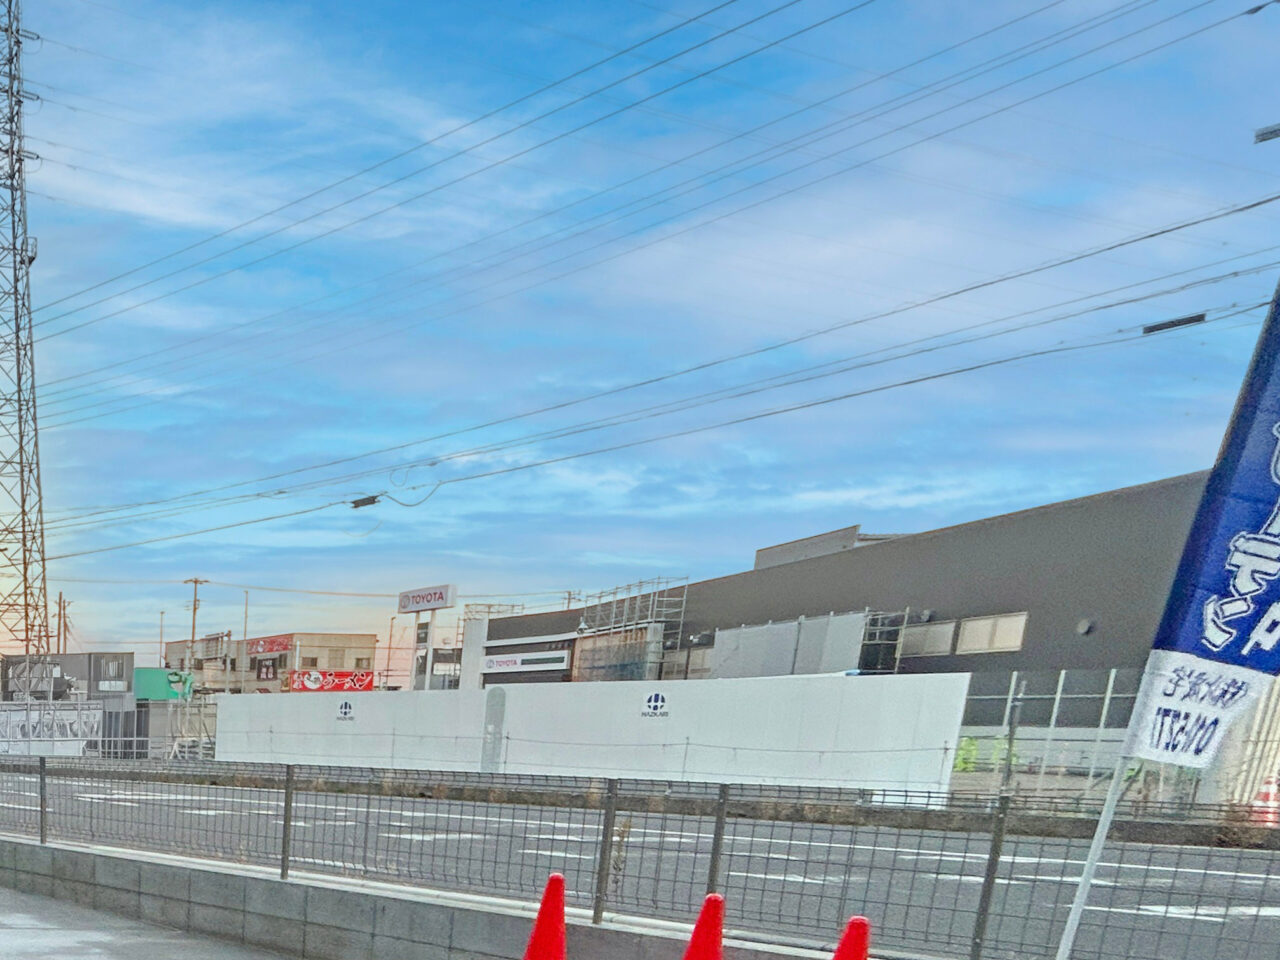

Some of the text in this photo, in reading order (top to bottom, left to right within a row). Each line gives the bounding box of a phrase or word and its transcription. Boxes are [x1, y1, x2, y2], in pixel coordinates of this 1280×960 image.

[410, 591, 444, 605] TOYOTA
[321, 672, 372, 689] ラーメン
